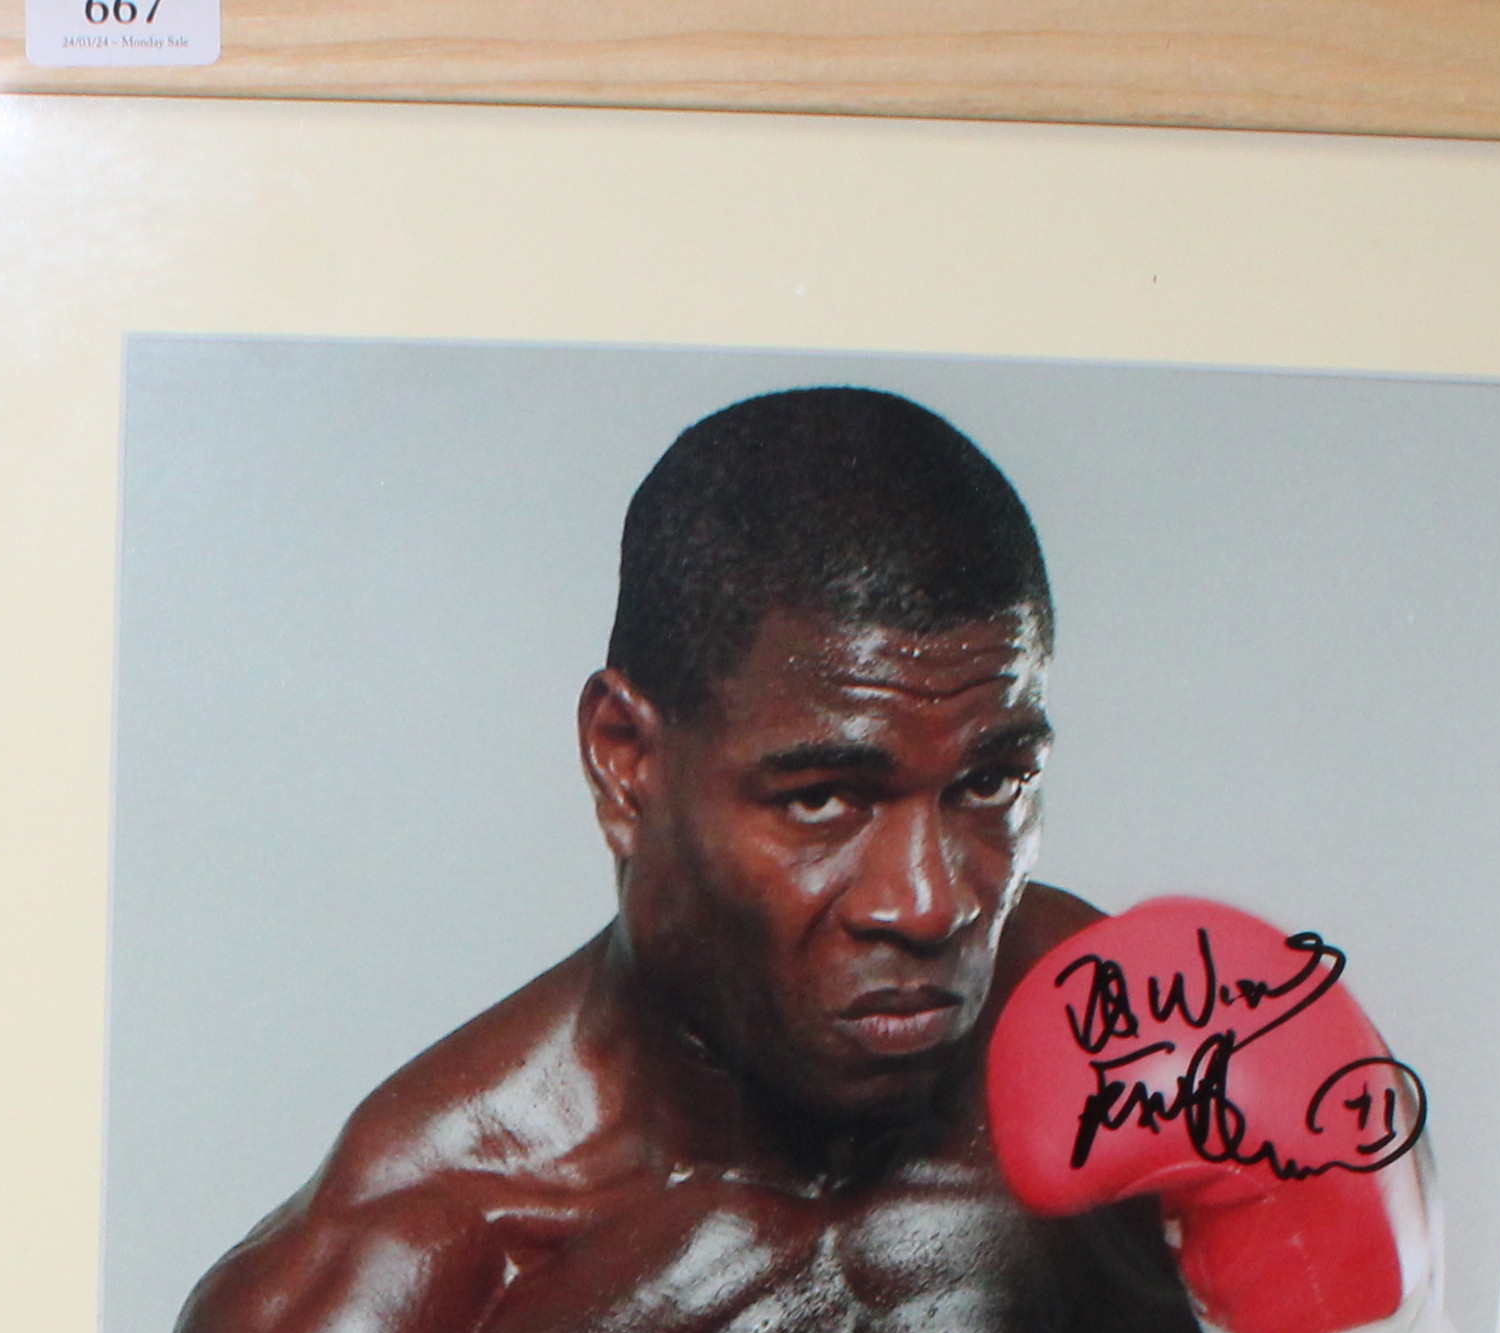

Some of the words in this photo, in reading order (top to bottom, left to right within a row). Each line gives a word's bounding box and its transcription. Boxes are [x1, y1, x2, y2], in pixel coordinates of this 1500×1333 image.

[84, 0, 161, 24] 667
[121, 35, 164, 49] Monday
[167, 35, 189, 48] Sale
